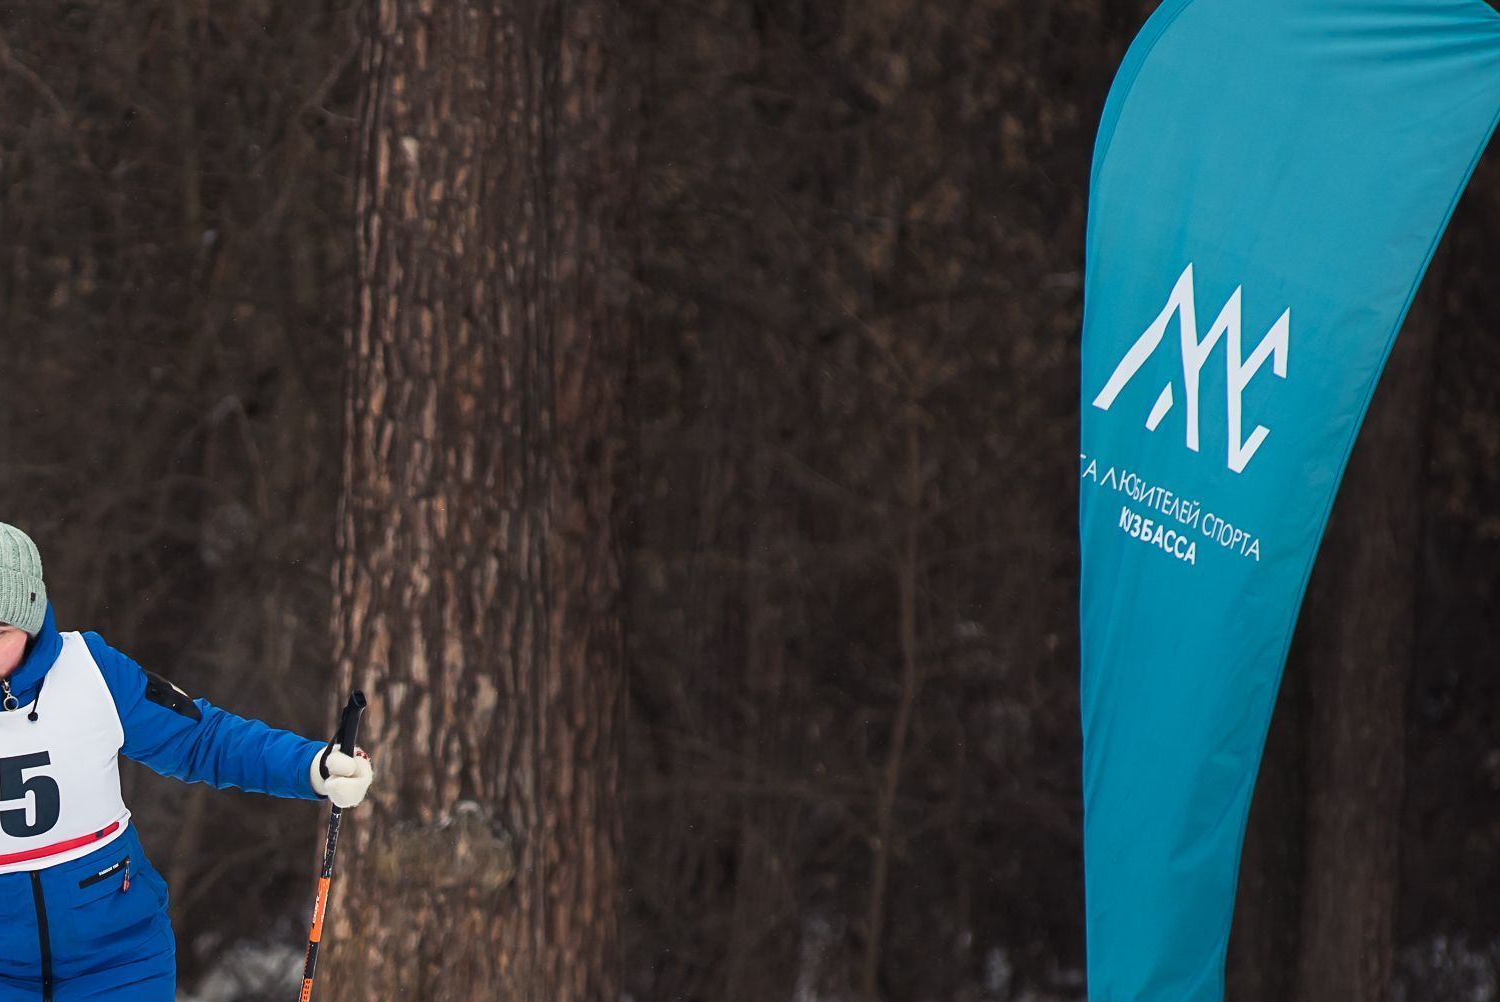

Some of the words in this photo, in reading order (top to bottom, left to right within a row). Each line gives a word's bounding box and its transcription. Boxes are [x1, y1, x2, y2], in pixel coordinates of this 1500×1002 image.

[1080, 453, 1097, 482] А
[1100, 466, 1200, 528] ЛЮБИТЕЛЕЙ
[1202, 513, 1259, 561] СПОРТА
[1118, 505, 1196, 565] КУЗБАССА
